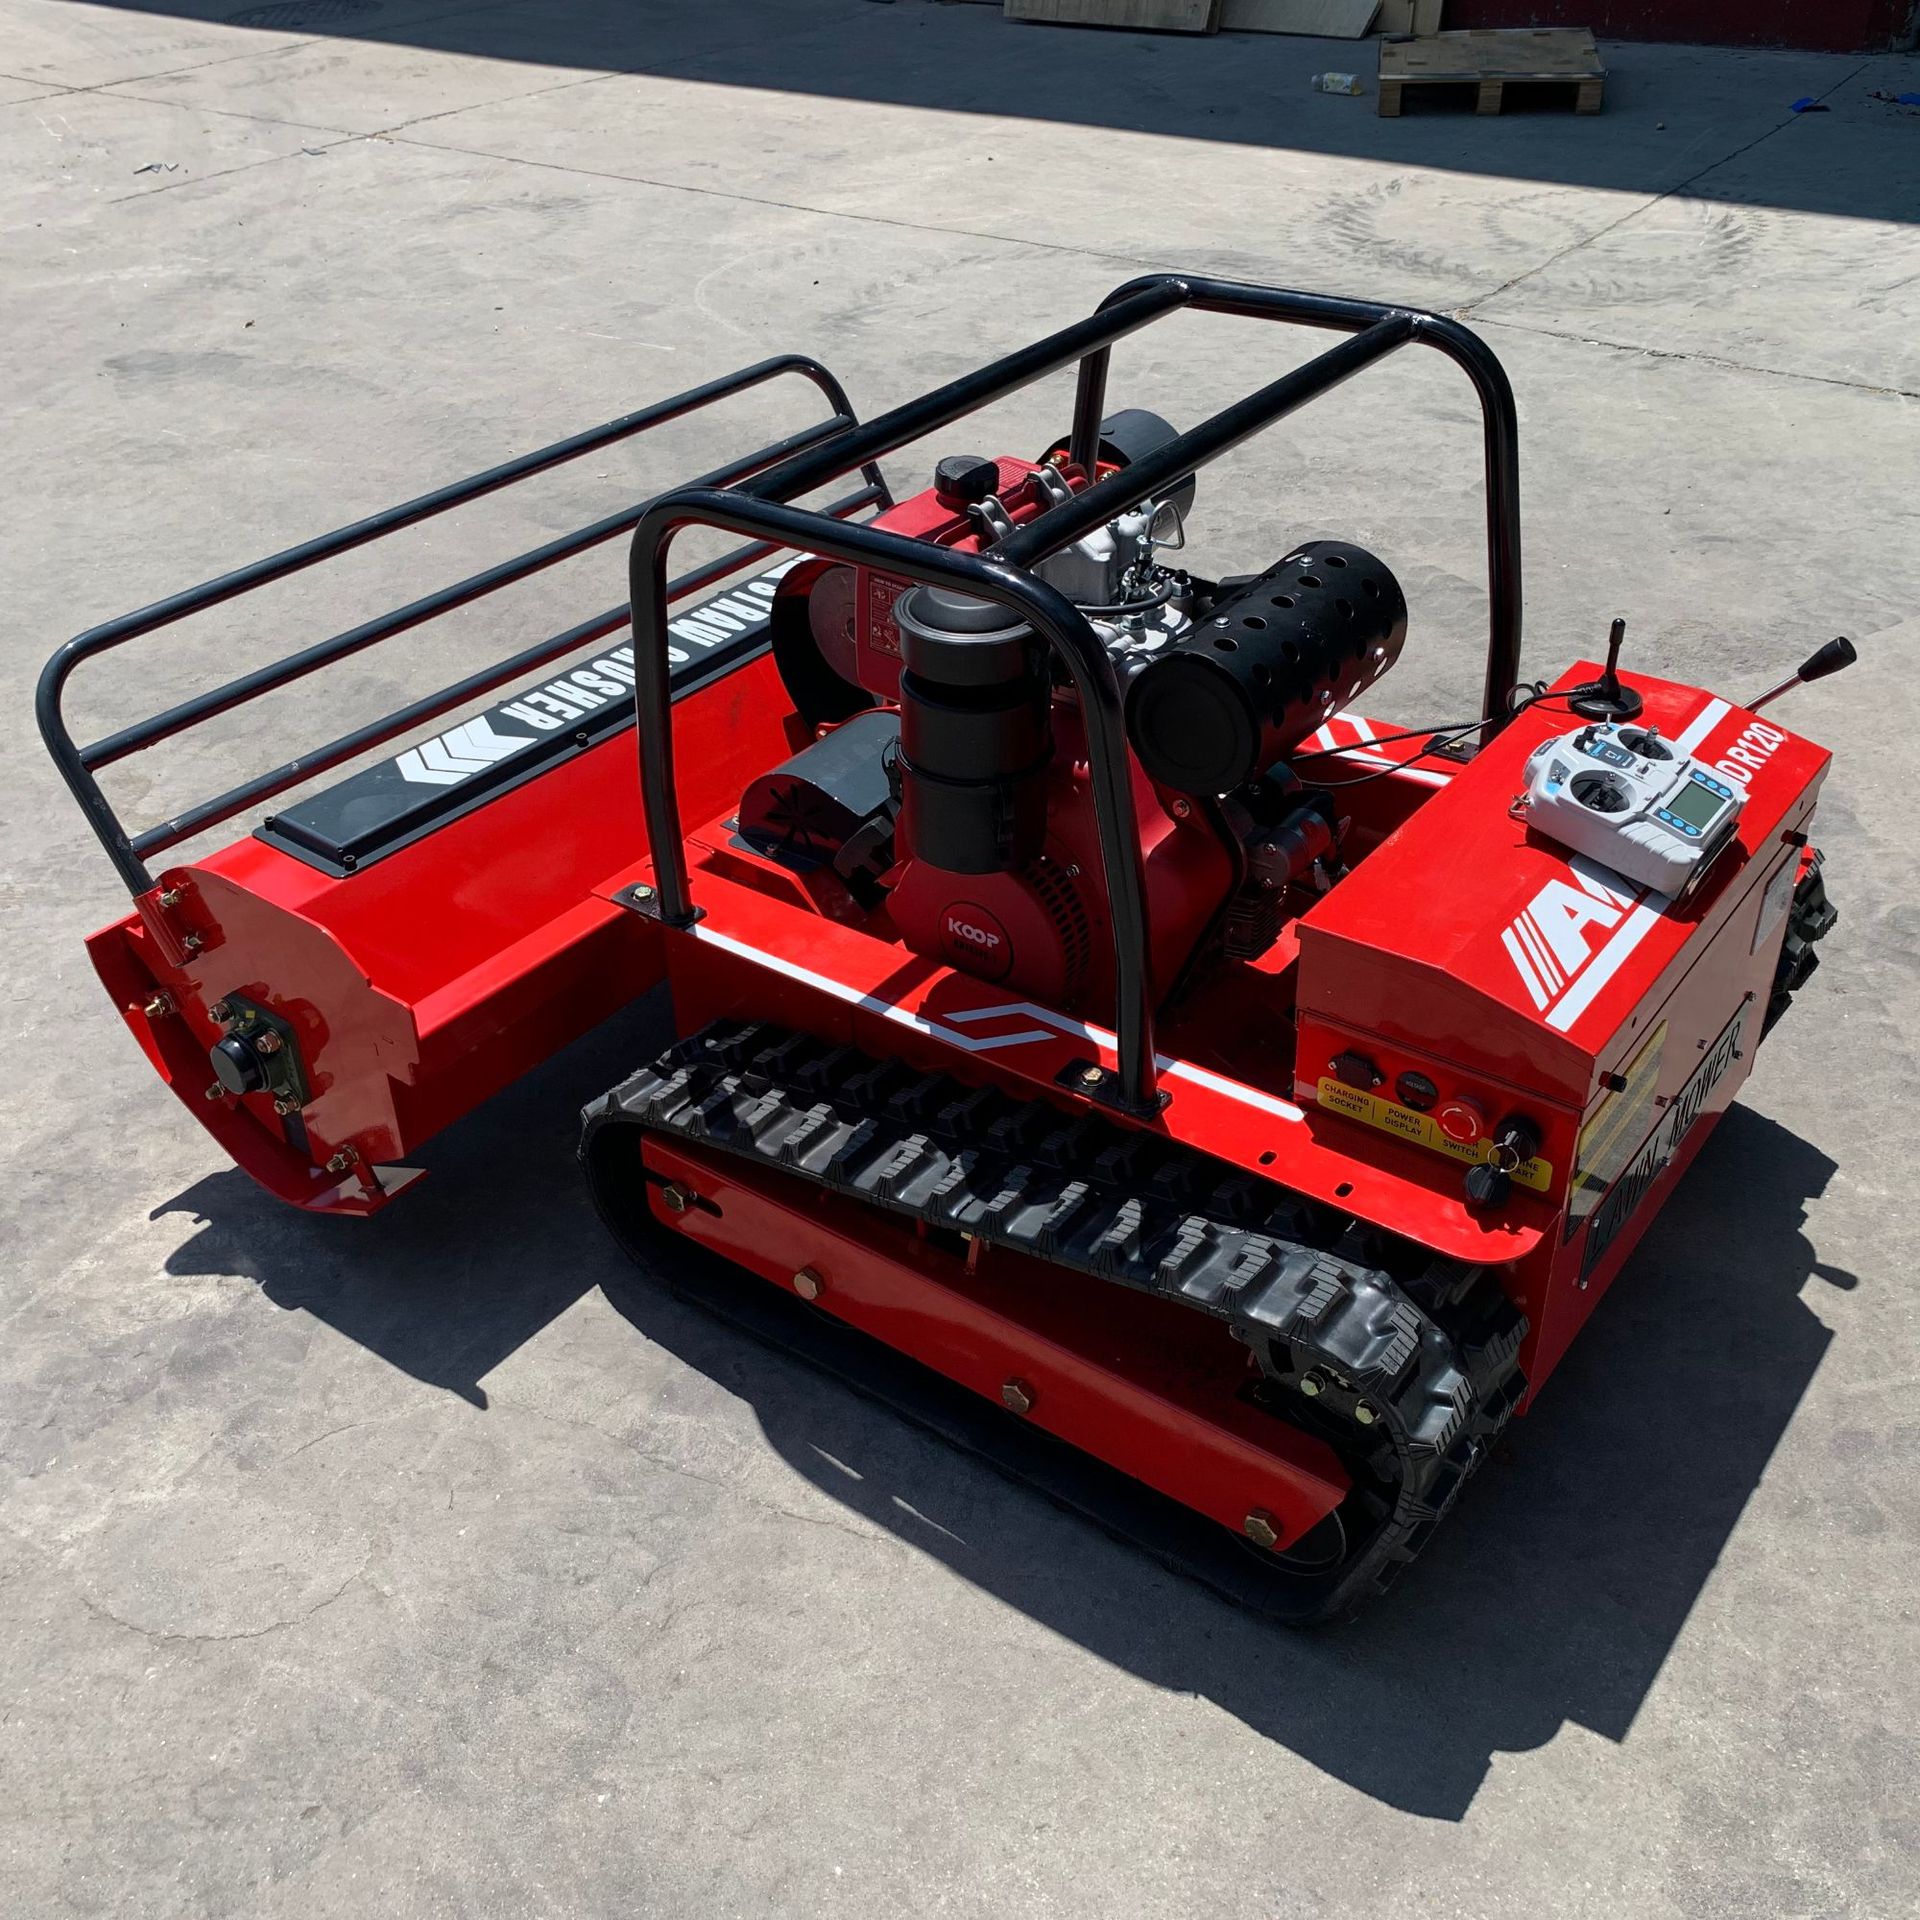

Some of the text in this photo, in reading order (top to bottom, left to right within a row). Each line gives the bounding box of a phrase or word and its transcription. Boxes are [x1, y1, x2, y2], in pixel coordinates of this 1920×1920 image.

[948, 917, 999, 948] KOOP
[1324, 1083, 1370, 1106] CHARGING
[1667, 1020, 1741, 1151] MOWER
[1328, 1095, 1363, 1114] SOCKET
[1384, 1116, 1422, 1137] DISPLAY
[1387, 1108, 1421, 1126] POWER
[1442, 1138, 1479, 1158] SWITCH
